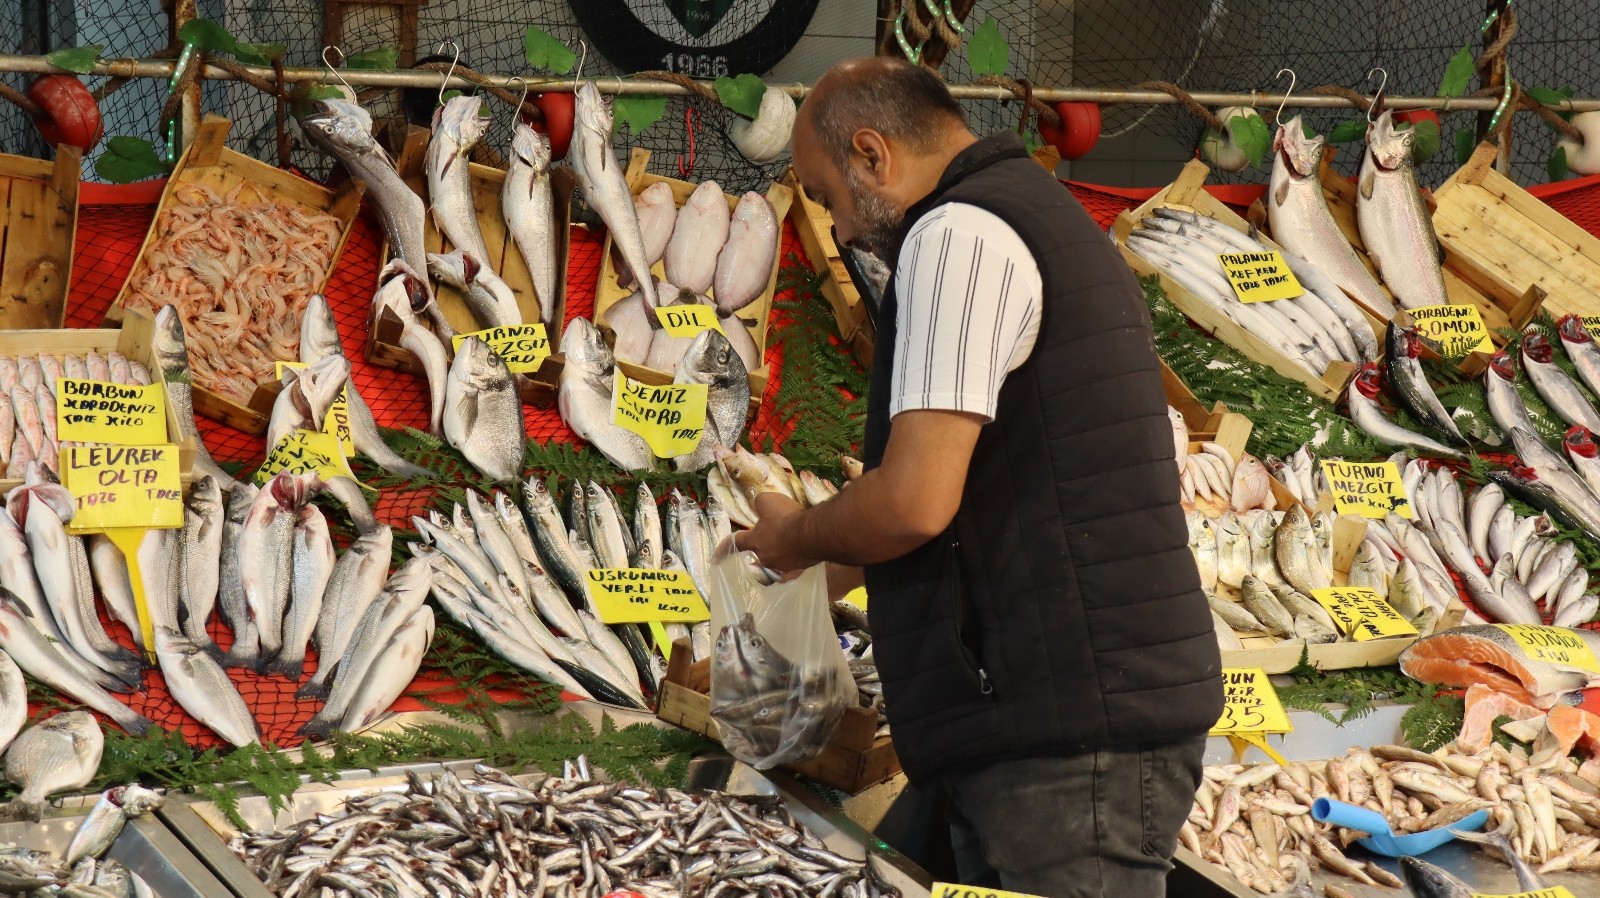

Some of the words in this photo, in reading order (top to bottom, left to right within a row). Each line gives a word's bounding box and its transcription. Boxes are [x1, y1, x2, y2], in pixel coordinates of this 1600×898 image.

[661, 53, 728, 78] 1966
[1220, 252, 1274, 266] PALAMUT
[64, 381, 144, 399] BARBUN
[71, 447, 166, 469] LEVREK
[99, 469, 158, 486] OLTA
[1326, 463, 1385, 480] TURNA
[75, 492, 117, 510] TAZE
[589, 570, 678, 581] USKUMRU
[1520, 632, 1584, 649] SOMON
